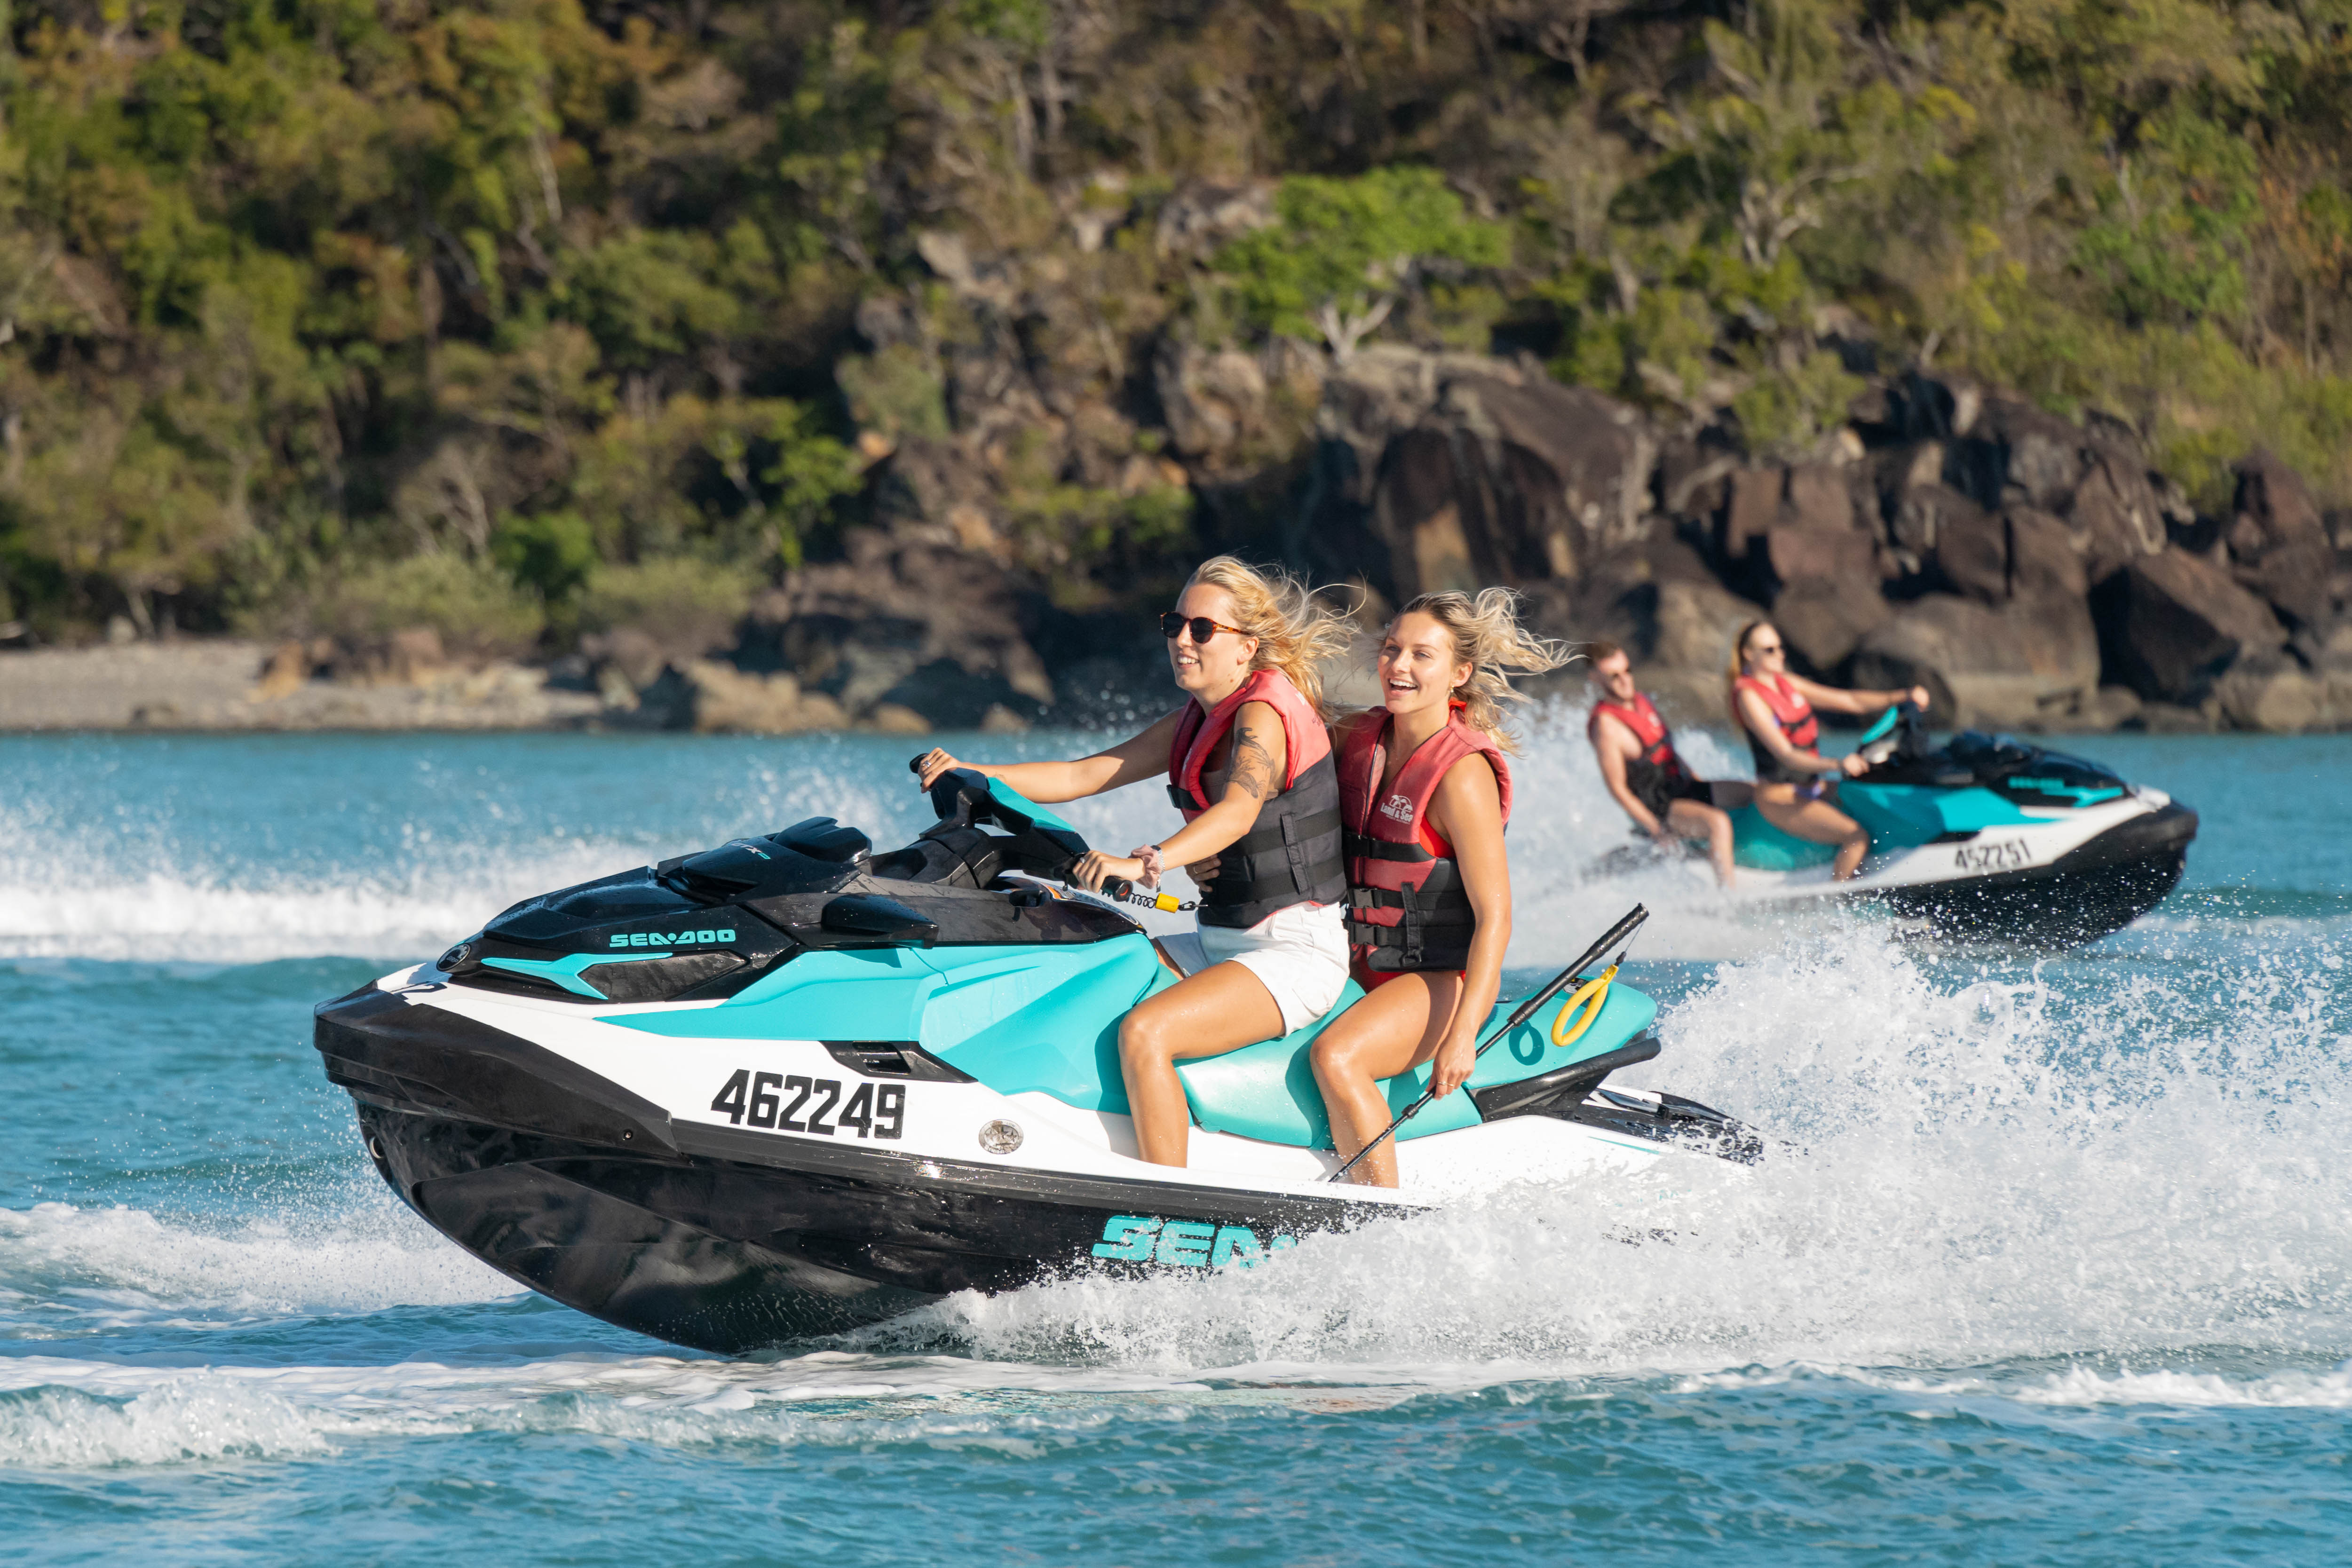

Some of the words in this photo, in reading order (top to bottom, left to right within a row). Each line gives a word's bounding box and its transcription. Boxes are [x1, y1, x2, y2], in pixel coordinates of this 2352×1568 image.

[1380, 802, 1396, 817] Land
[1394, 810, 1400, 818] &
[1400, 808, 1413, 822] Sea
[711, 1069, 906, 1140] 462249
